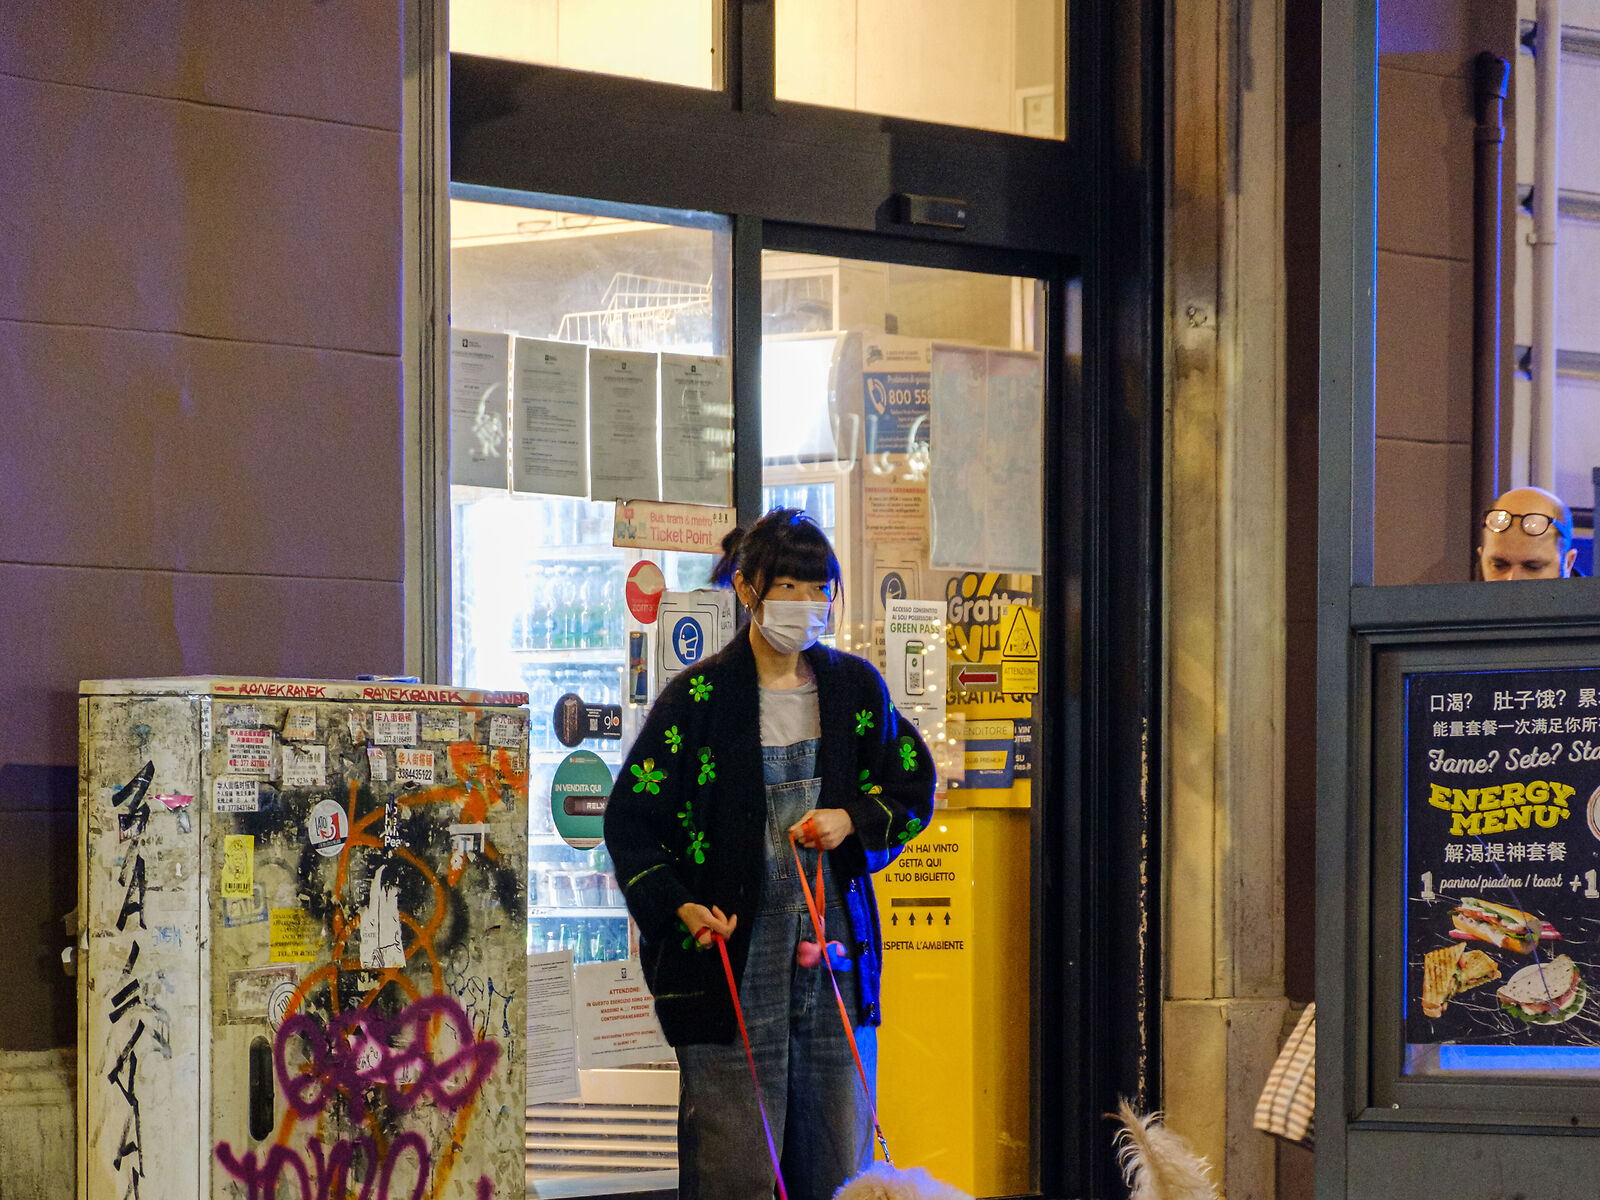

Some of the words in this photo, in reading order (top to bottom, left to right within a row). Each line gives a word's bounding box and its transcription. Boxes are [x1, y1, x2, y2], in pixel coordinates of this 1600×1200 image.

[888, 390, 912, 406] 800
[667, 513, 684, 525] tram
[691, 516, 713, 527] metro
[650, 527, 683, 544] Ticket
[686, 529, 713, 546] Point
[890, 622, 918, 634] GREEN
[920, 623, 941, 634] PASS
[1004, 667, 1036, 676] ATTENZIONE
[1430, 693, 1473, 712] 口渴?
[1493, 689, 1566, 711] 肚子饿?
[604, 710, 620, 730] glo
[1433, 716, 1600, 737] 能量套餐一次满足你所
[1428, 749, 1500, 774] Fame?
[1505, 742, 1563, 772] Sete?
[554, 784, 562, 792] IN
[563, 784, 590, 793] VENDITA
[590, 784, 602, 794] QUI
[1428, 780, 1576, 812] ENERGY
[916, 844, 931, 854] HAI
[932, 844, 959, 853] VINTO
[1444, 842, 1568, 863] 解渴提神套餐
[898, 858, 924, 868] GETTA
[926, 858, 942, 868] QUI
[886, 873, 892, 882] IL
[894, 872, 912, 882] TUO
[914, 872, 956, 882] BIGLIETTO
[1421, 871, 1436, 900] 1
[1532, 873, 1564, 888] toast
[916, 940, 964, 950] L'AMBIENTE
